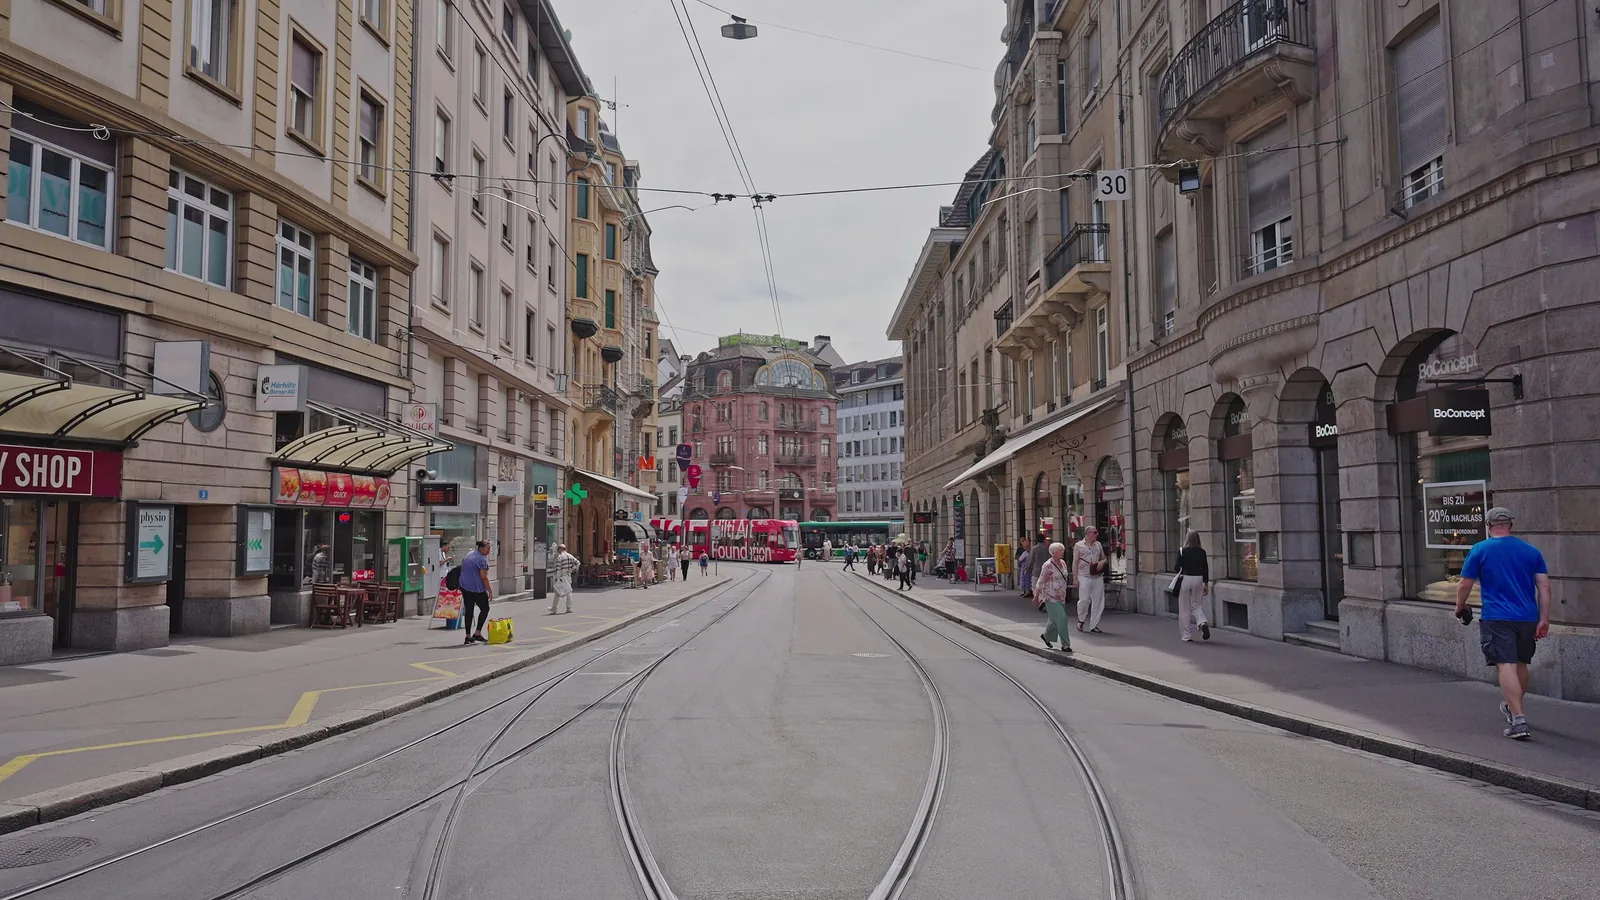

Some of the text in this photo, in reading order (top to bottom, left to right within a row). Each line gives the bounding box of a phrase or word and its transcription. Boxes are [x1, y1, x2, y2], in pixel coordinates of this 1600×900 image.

[1101, 175, 1127, 195] 30
[1419, 352, 1478, 380] BoConcept
[270, 381, 297, 389] Hörhilfe
[1434, 408, 1485, 420] BoConcept
[638, 455, 655, 470] M
[15, 452, 81, 489] SHOP
[537, 485, 544, 494] D
[1442, 496, 1465, 506] BIS ZU
[140, 511, 166, 524] physio
[1428, 508, 1483, 523] 20% NACHLASS
